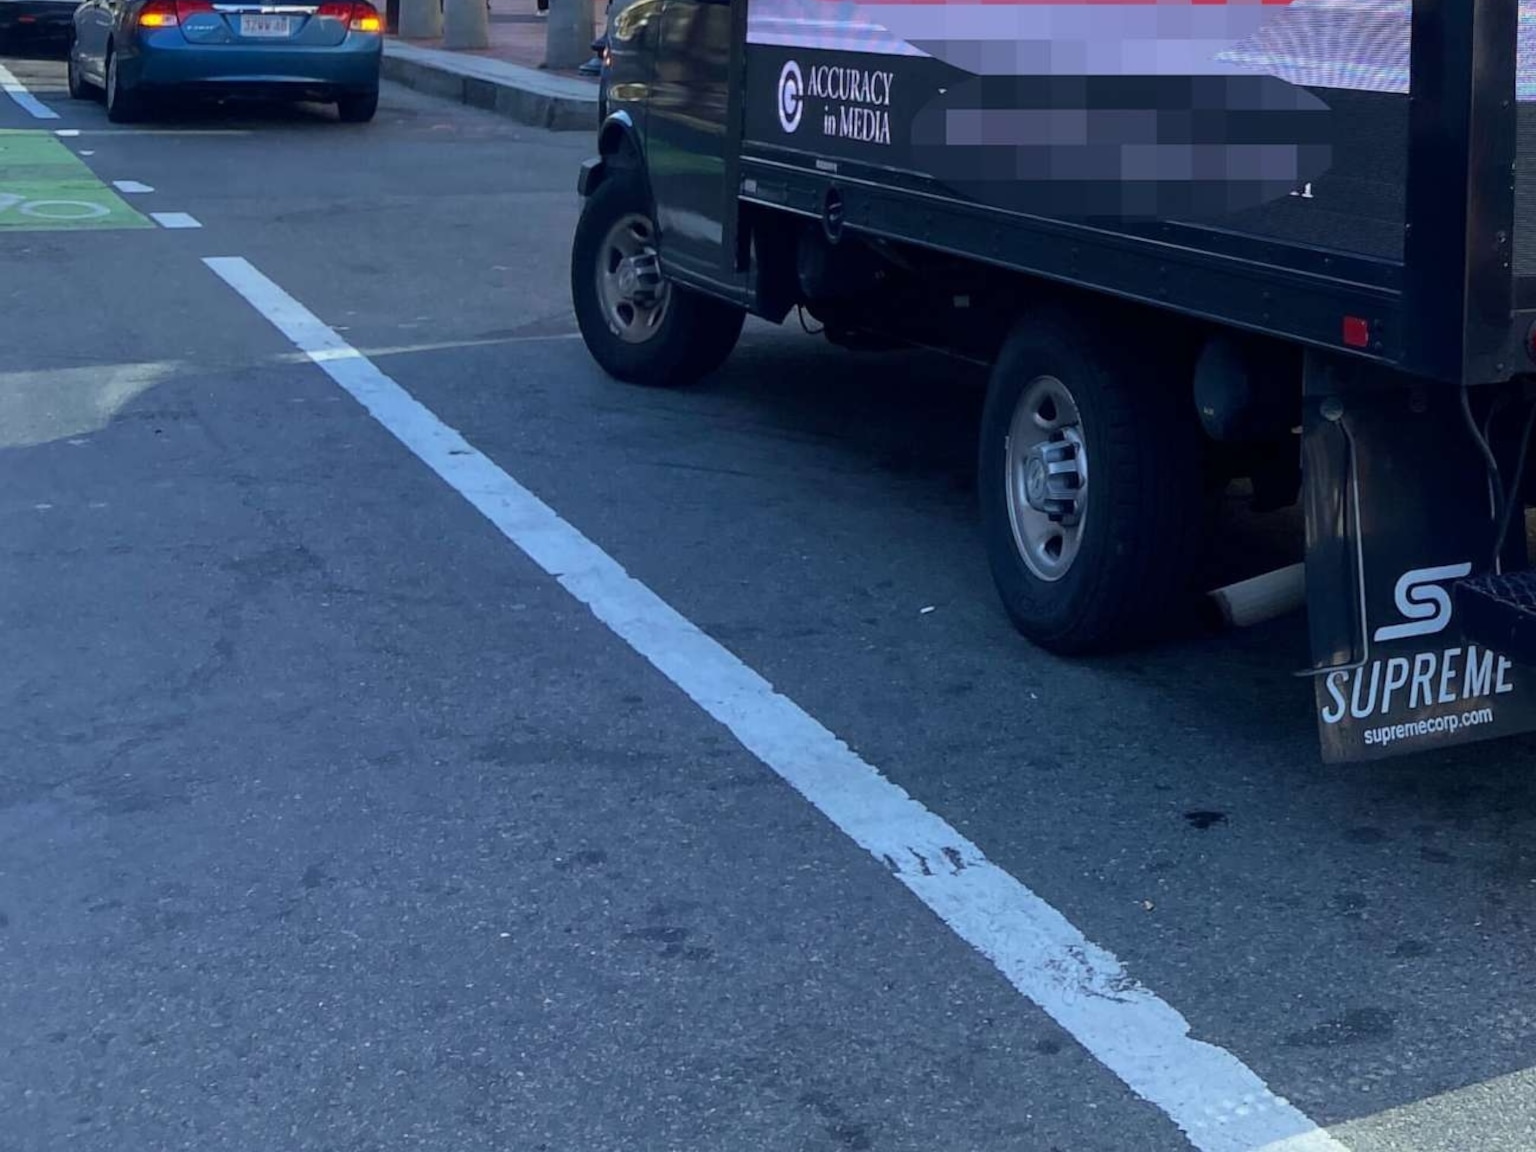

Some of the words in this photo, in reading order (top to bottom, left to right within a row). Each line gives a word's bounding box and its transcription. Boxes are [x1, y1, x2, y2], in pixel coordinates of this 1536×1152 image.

[807, 65, 893, 106] ACCURACY
[823, 105, 836, 136] in
[839, 105, 891, 145] MEDIA
[1322, 644, 1514, 724] SUPREME
[1363, 707, 1494, 746] supremecorp.com
